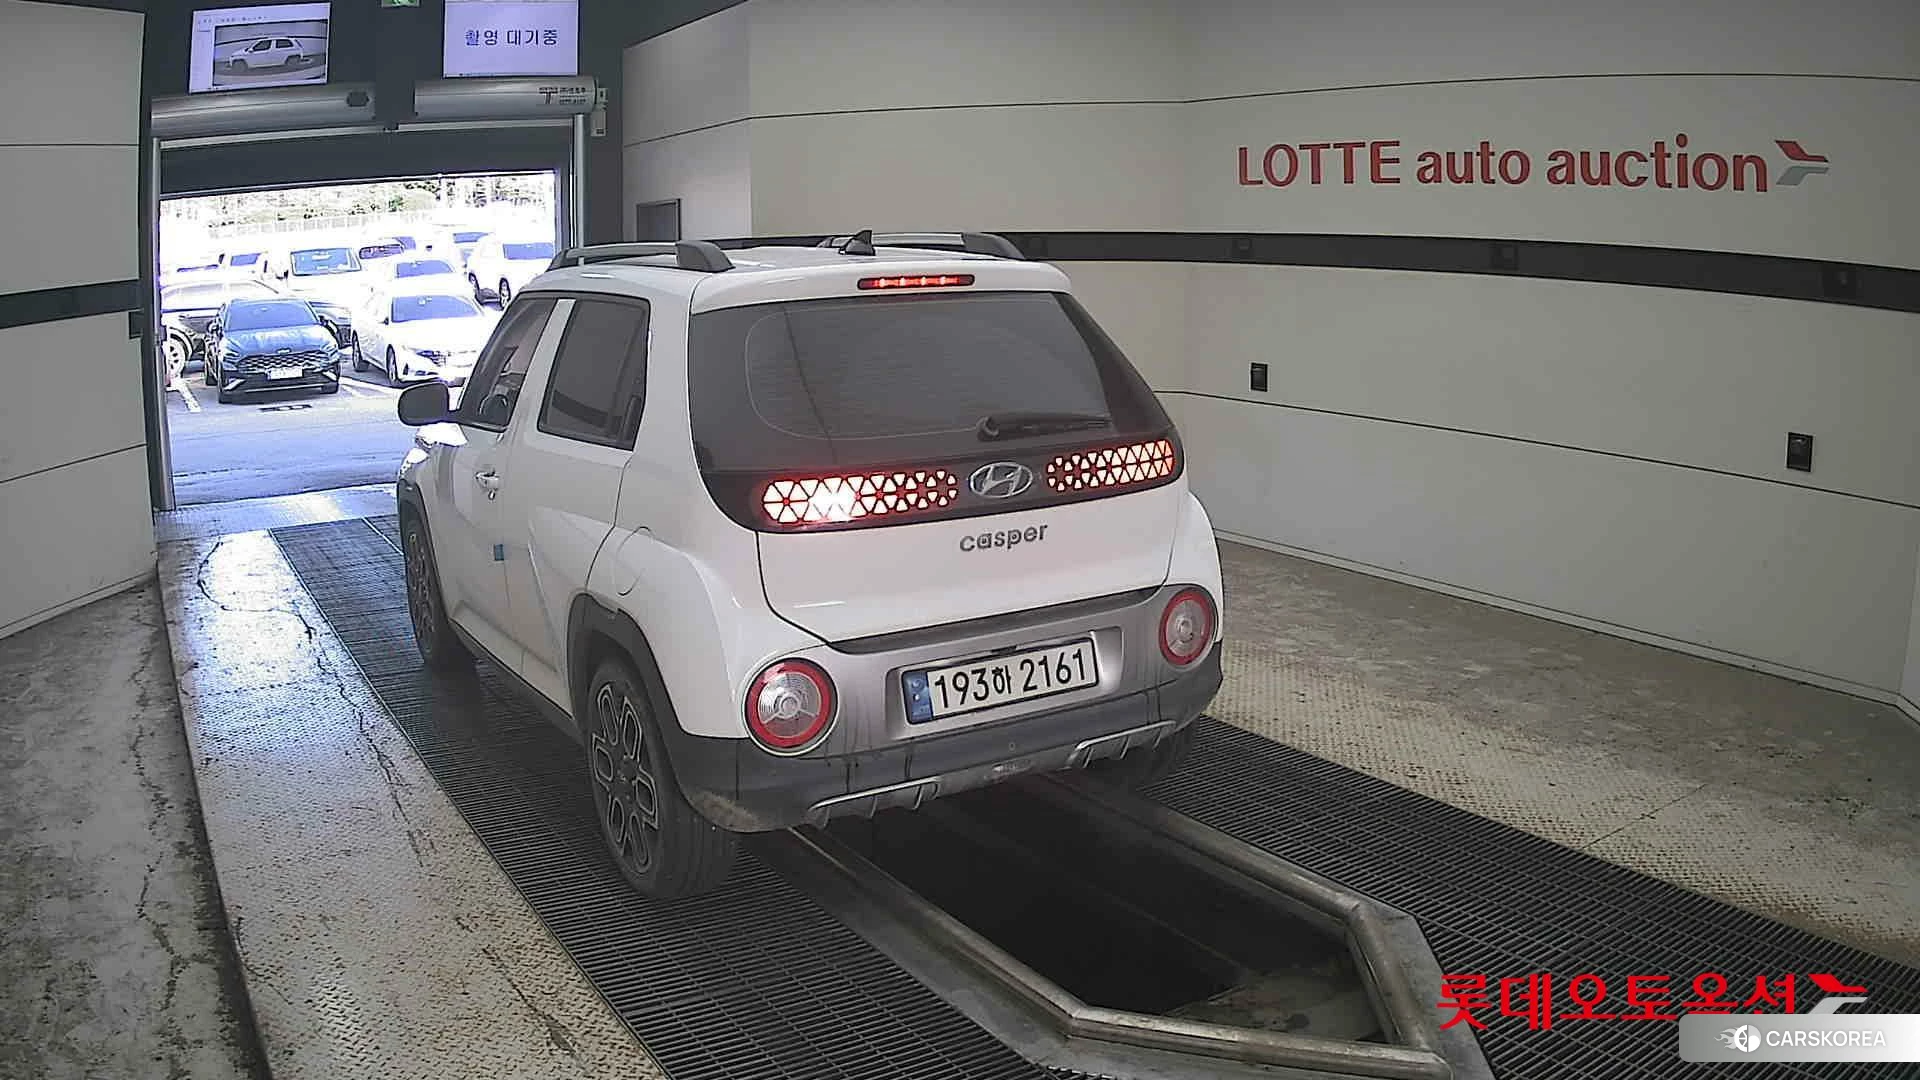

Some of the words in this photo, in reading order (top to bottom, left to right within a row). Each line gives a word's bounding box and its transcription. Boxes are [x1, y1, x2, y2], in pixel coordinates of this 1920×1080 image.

[465, 29, 499, 46] 촬영
[506, 28, 558, 46] 대기중
[1238, 139, 1400, 187] LOTTE
[1416, 141, 1530, 184] auto
[1546, 133, 1768, 192] auction
[959, 523, 1049, 552] casper
[934, 664, 1012, 709] 193하
[1019, 648, 1085, 692] 2161
